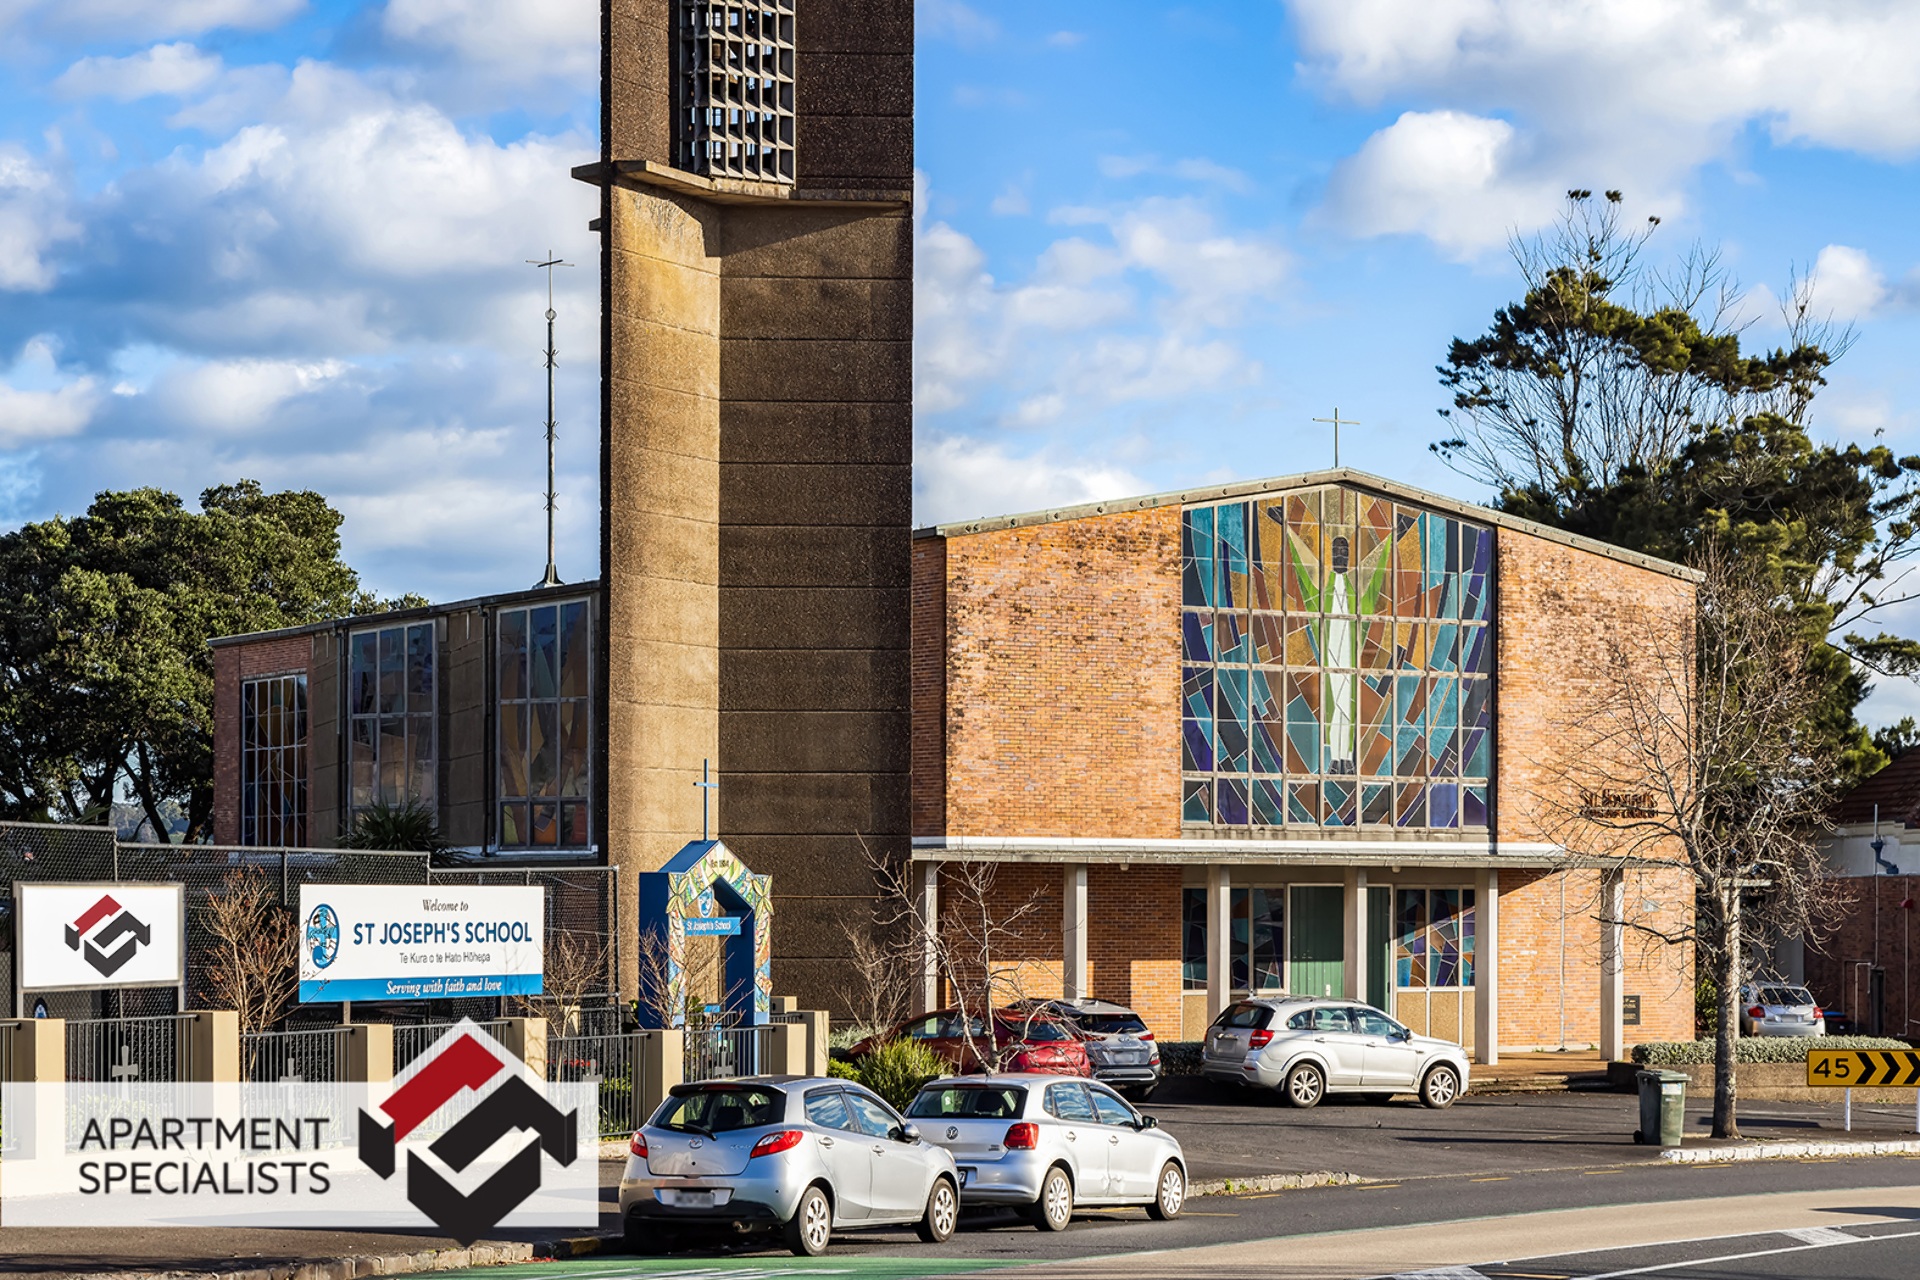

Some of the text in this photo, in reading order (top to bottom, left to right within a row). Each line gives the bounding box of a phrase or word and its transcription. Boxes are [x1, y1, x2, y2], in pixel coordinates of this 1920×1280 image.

[422, 898, 469, 912] Welcome to
[353, 921, 532, 945] ST JOSEPH'S SCHOOL
[399, 952, 409, 964] Te
[410, 952, 428, 964] Kura
[436, 952, 443, 963] te
[444, 951, 462, 963] Hato
[386, 977, 502, 997] Serving with faith and love
[1813, 1057, 1850, 1079] 45
